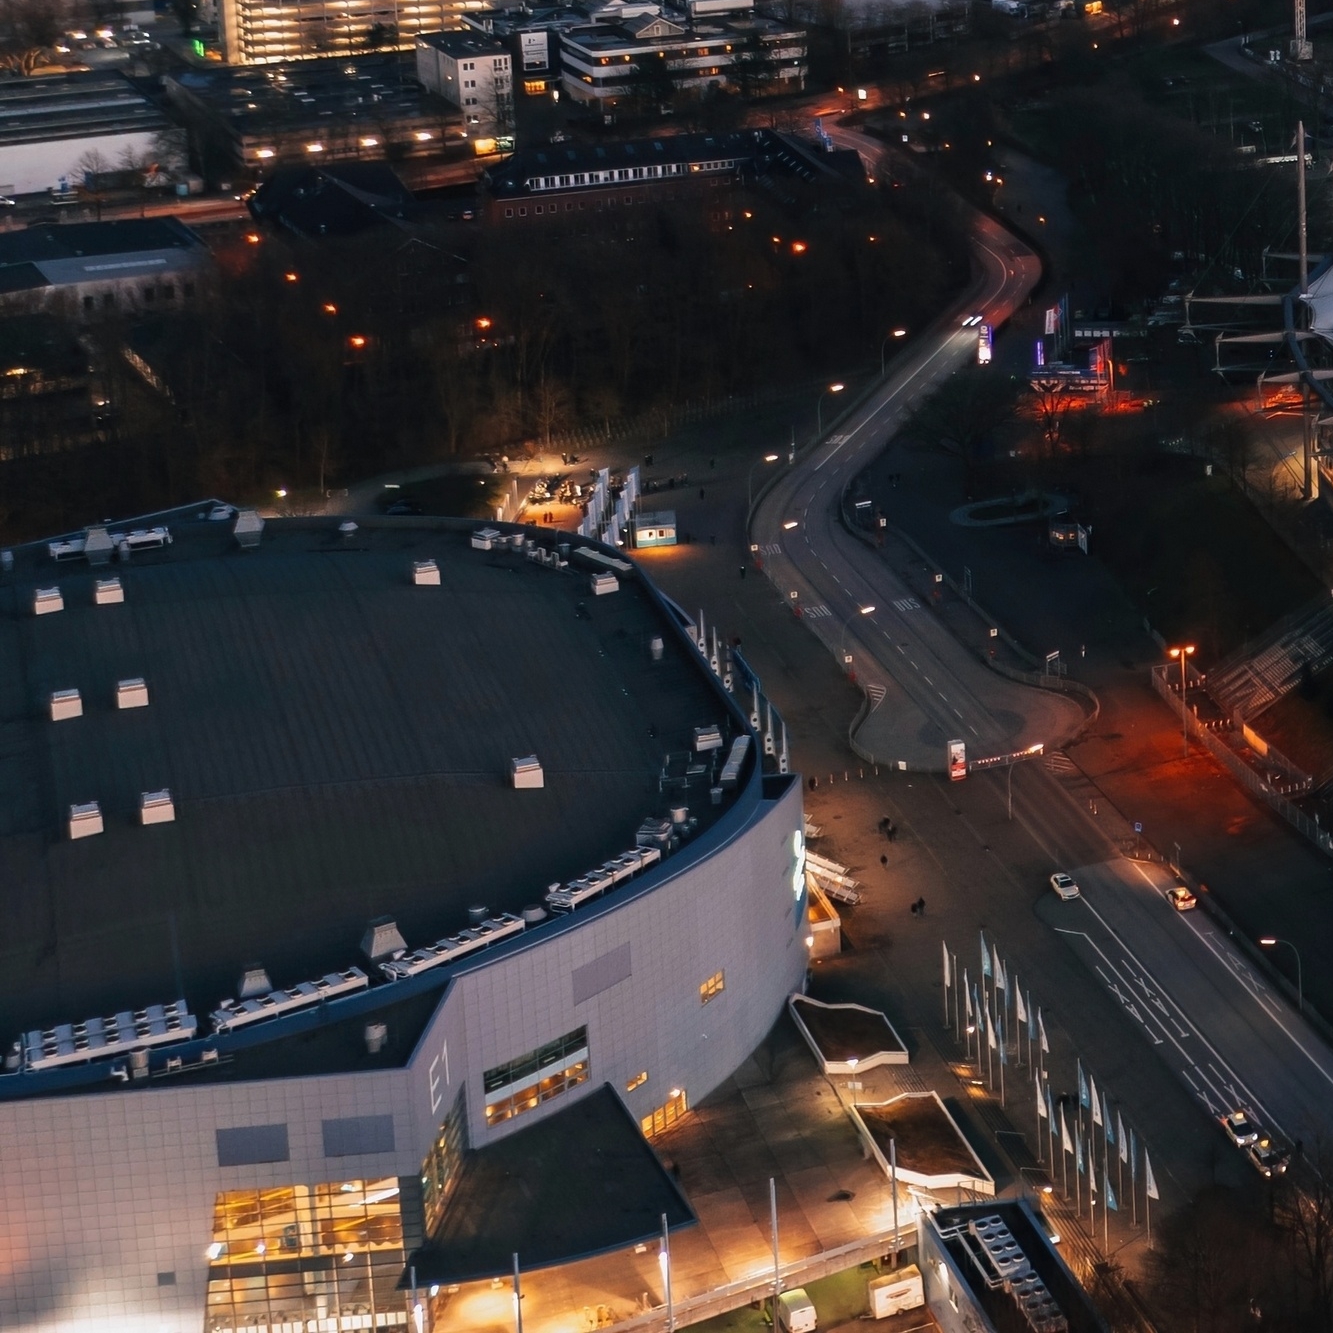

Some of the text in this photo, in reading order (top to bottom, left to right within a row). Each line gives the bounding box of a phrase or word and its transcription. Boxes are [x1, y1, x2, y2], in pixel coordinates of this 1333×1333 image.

[1095, 965, 1164, 1045] TAXI
[1121, 959, 1190, 1038] TAXI
[1204, 930, 1282, 1012] TAXI
[429, 1039, 450, 1115] E1
